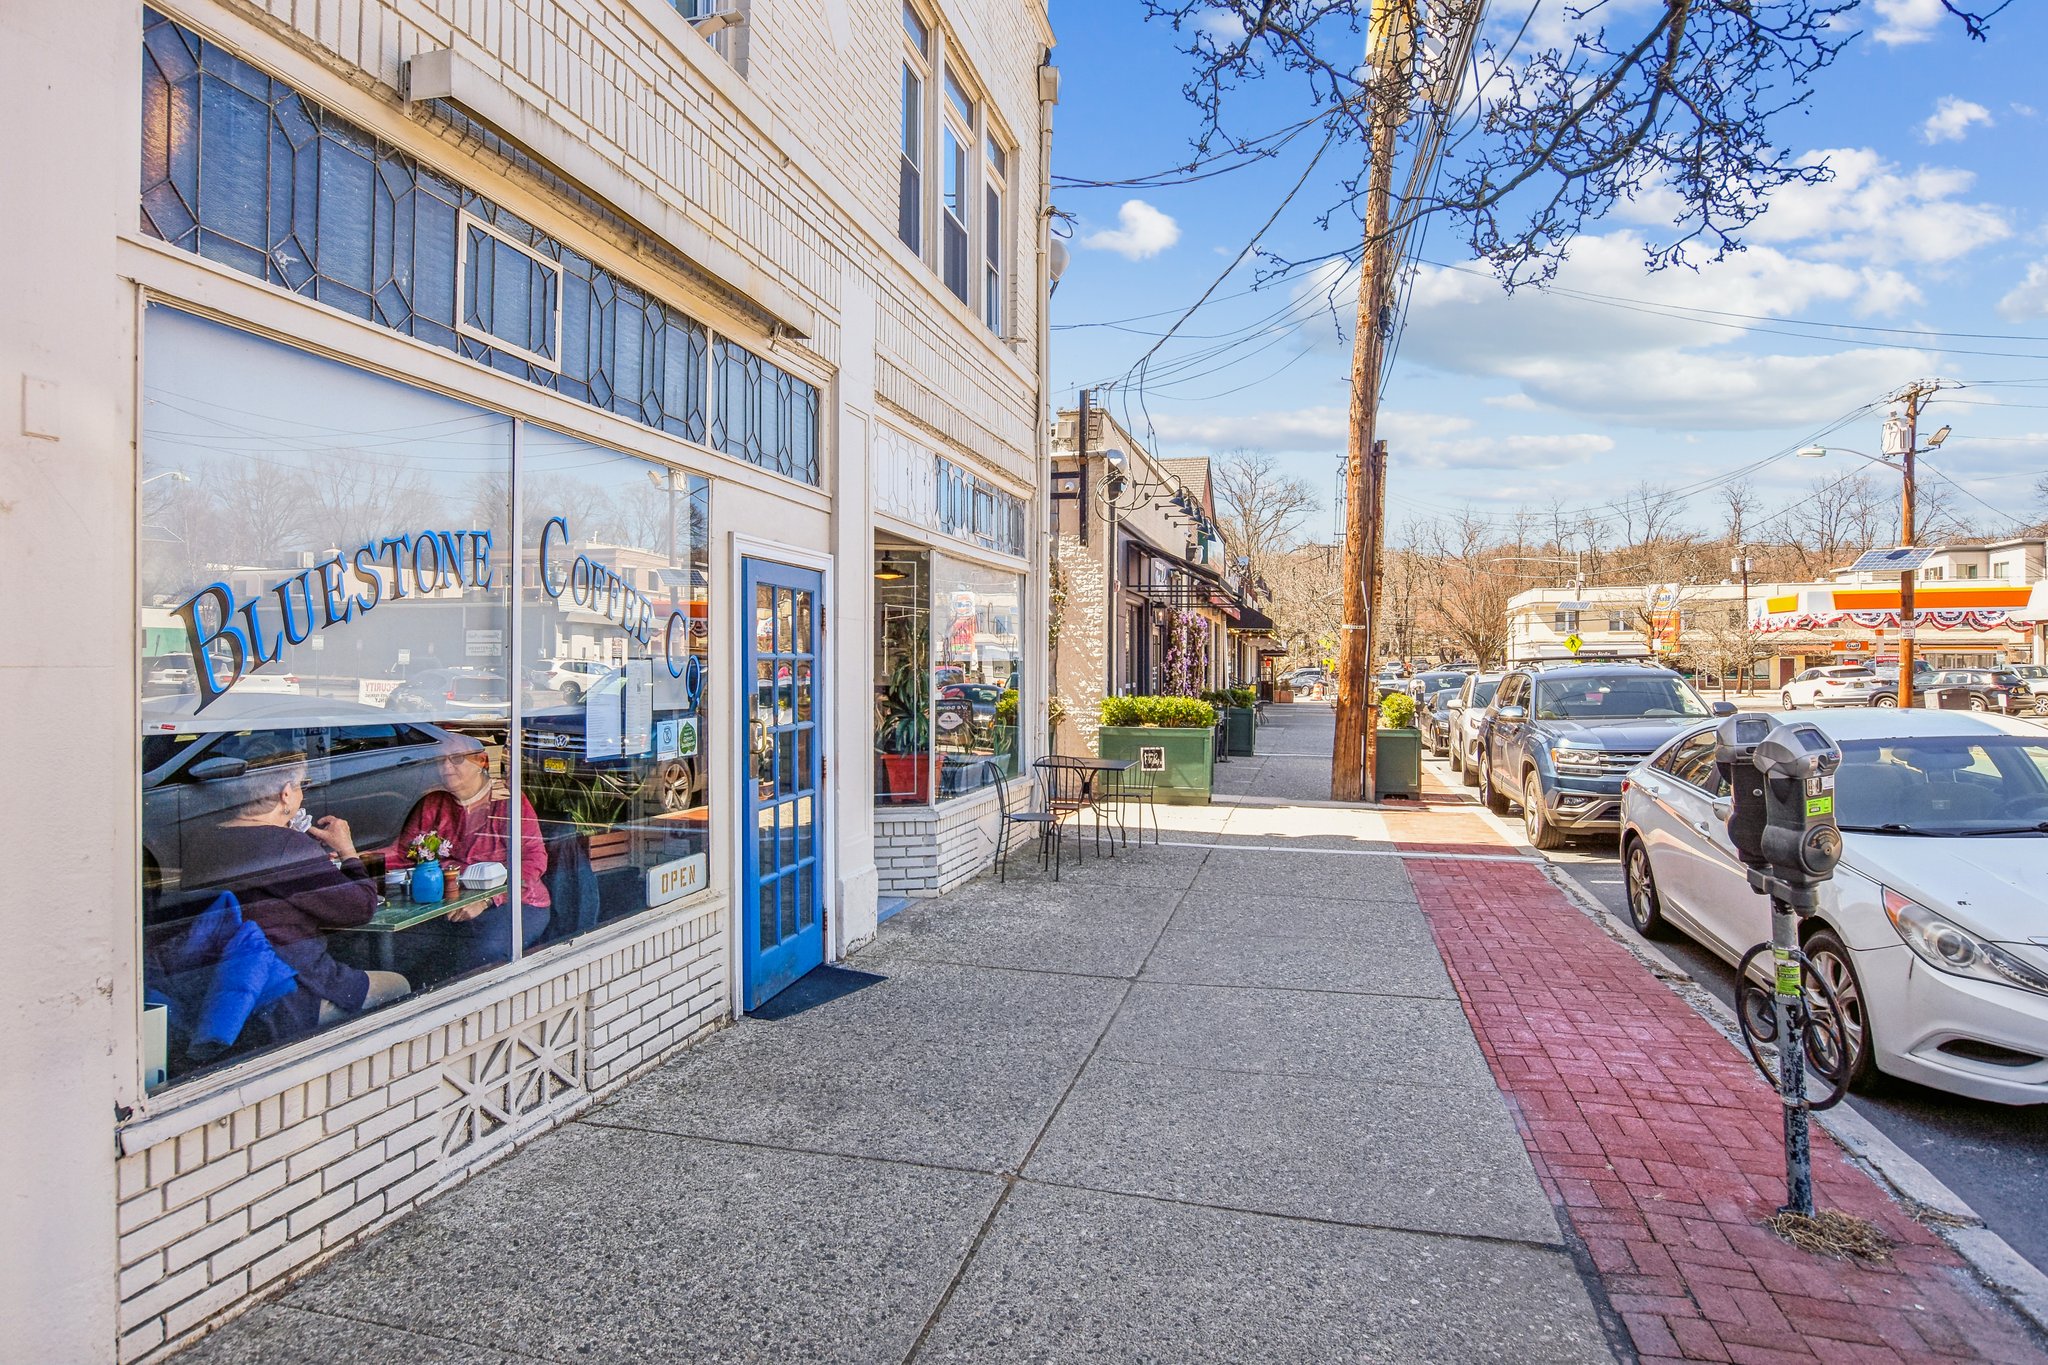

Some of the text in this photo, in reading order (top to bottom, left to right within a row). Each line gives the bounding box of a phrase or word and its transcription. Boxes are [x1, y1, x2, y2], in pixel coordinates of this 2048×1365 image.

[169, 529, 495, 716] BLUESTONE
[539, 516, 655, 648] COFFEE
[661, 864, 695, 894] OPEN
